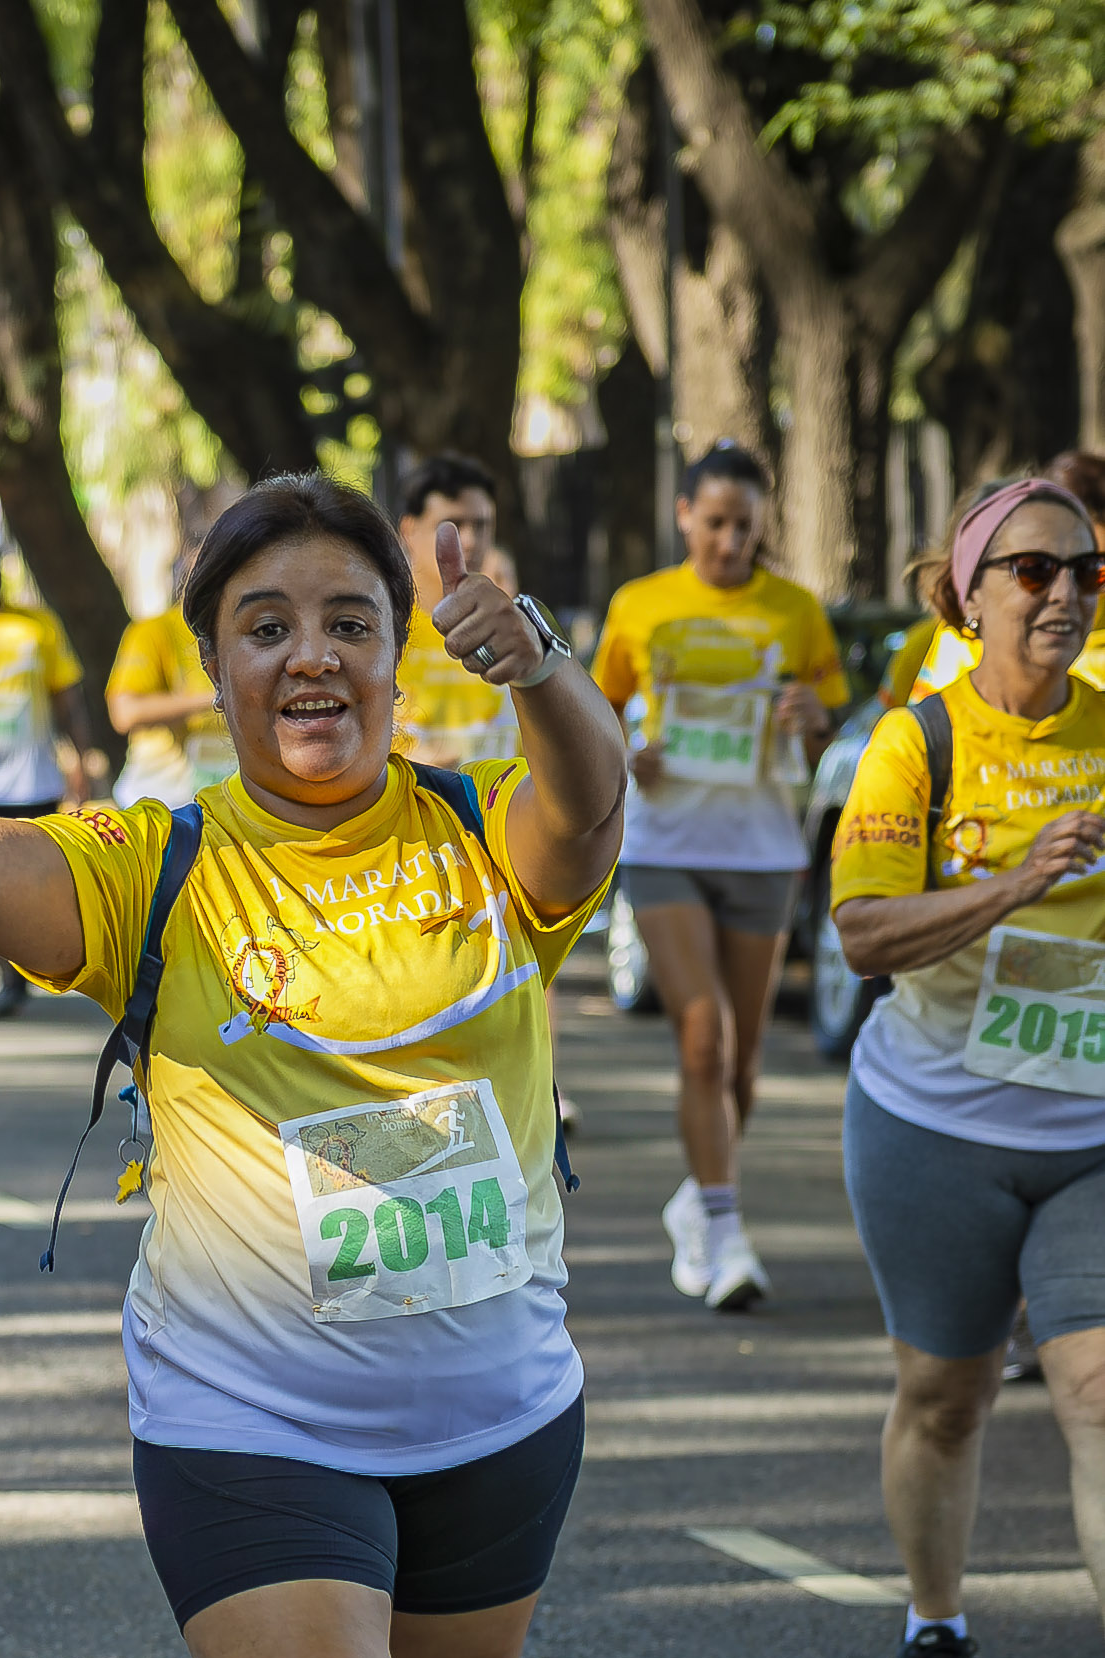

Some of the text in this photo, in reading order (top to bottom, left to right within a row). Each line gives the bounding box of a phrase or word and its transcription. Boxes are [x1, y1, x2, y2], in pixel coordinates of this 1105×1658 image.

[1006, 784, 1100, 810] DORADA
[979, 995, 1105, 1064] 2015
[320, 1177, 511, 1281] 2014
